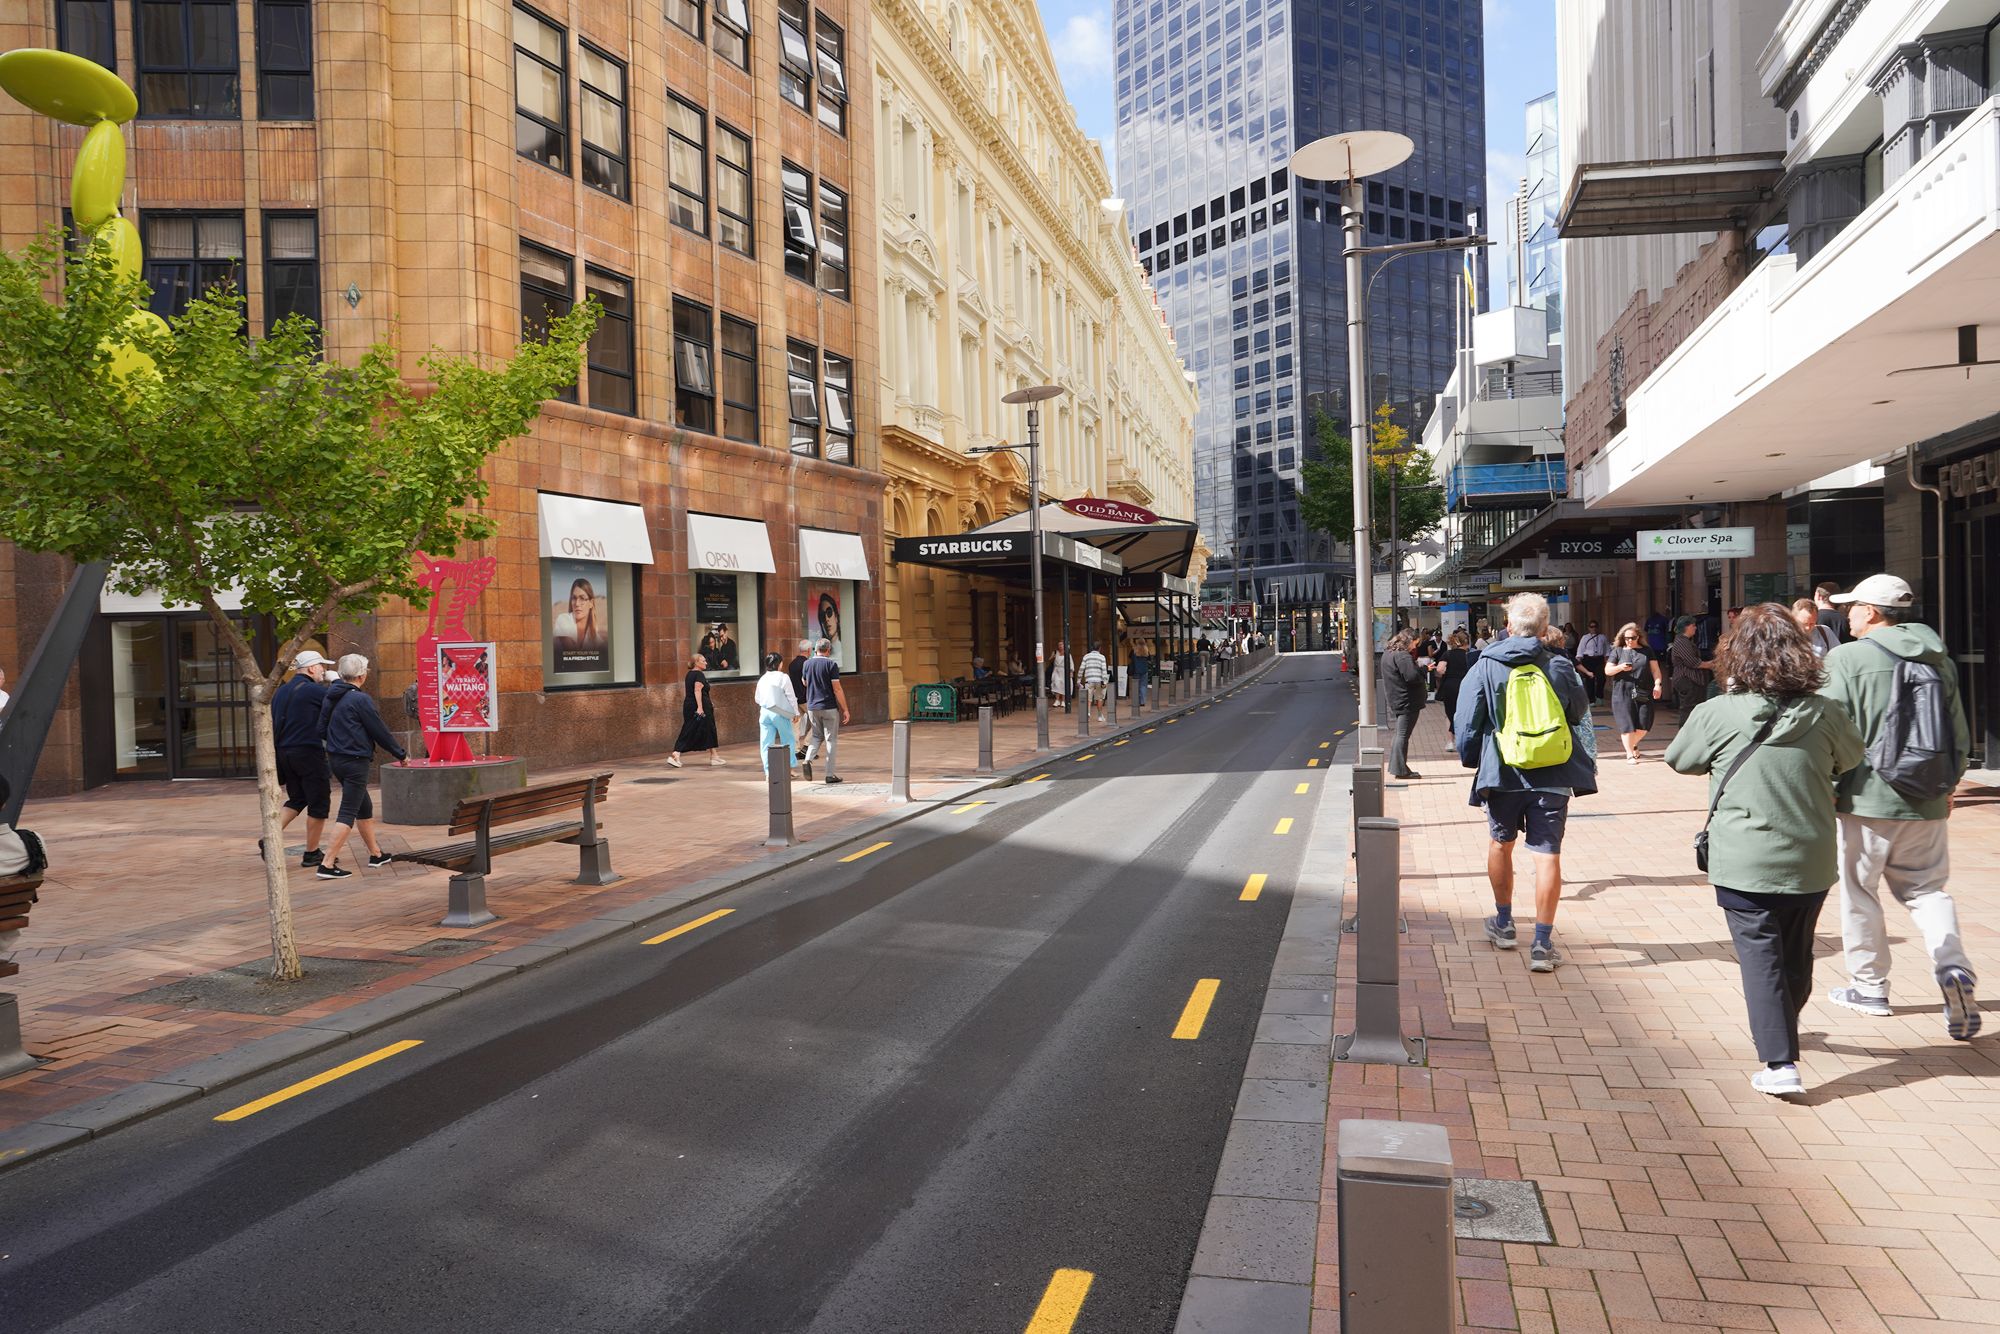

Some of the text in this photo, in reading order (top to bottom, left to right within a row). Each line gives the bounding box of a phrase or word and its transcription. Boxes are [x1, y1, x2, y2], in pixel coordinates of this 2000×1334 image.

[1076, 504, 1145, 522] OLD BANK
[919, 539, 1013, 555] STARBUCKS
[1560, 541, 1603, 553] RYOS
[1667, 534, 1733, 545] Clover Spa
[561, 537, 606, 558] OPSM
[706, 551, 739, 568] OPSM
[815, 561, 842, 576] OPSM
[446, 683, 486, 691] WAITANGI
